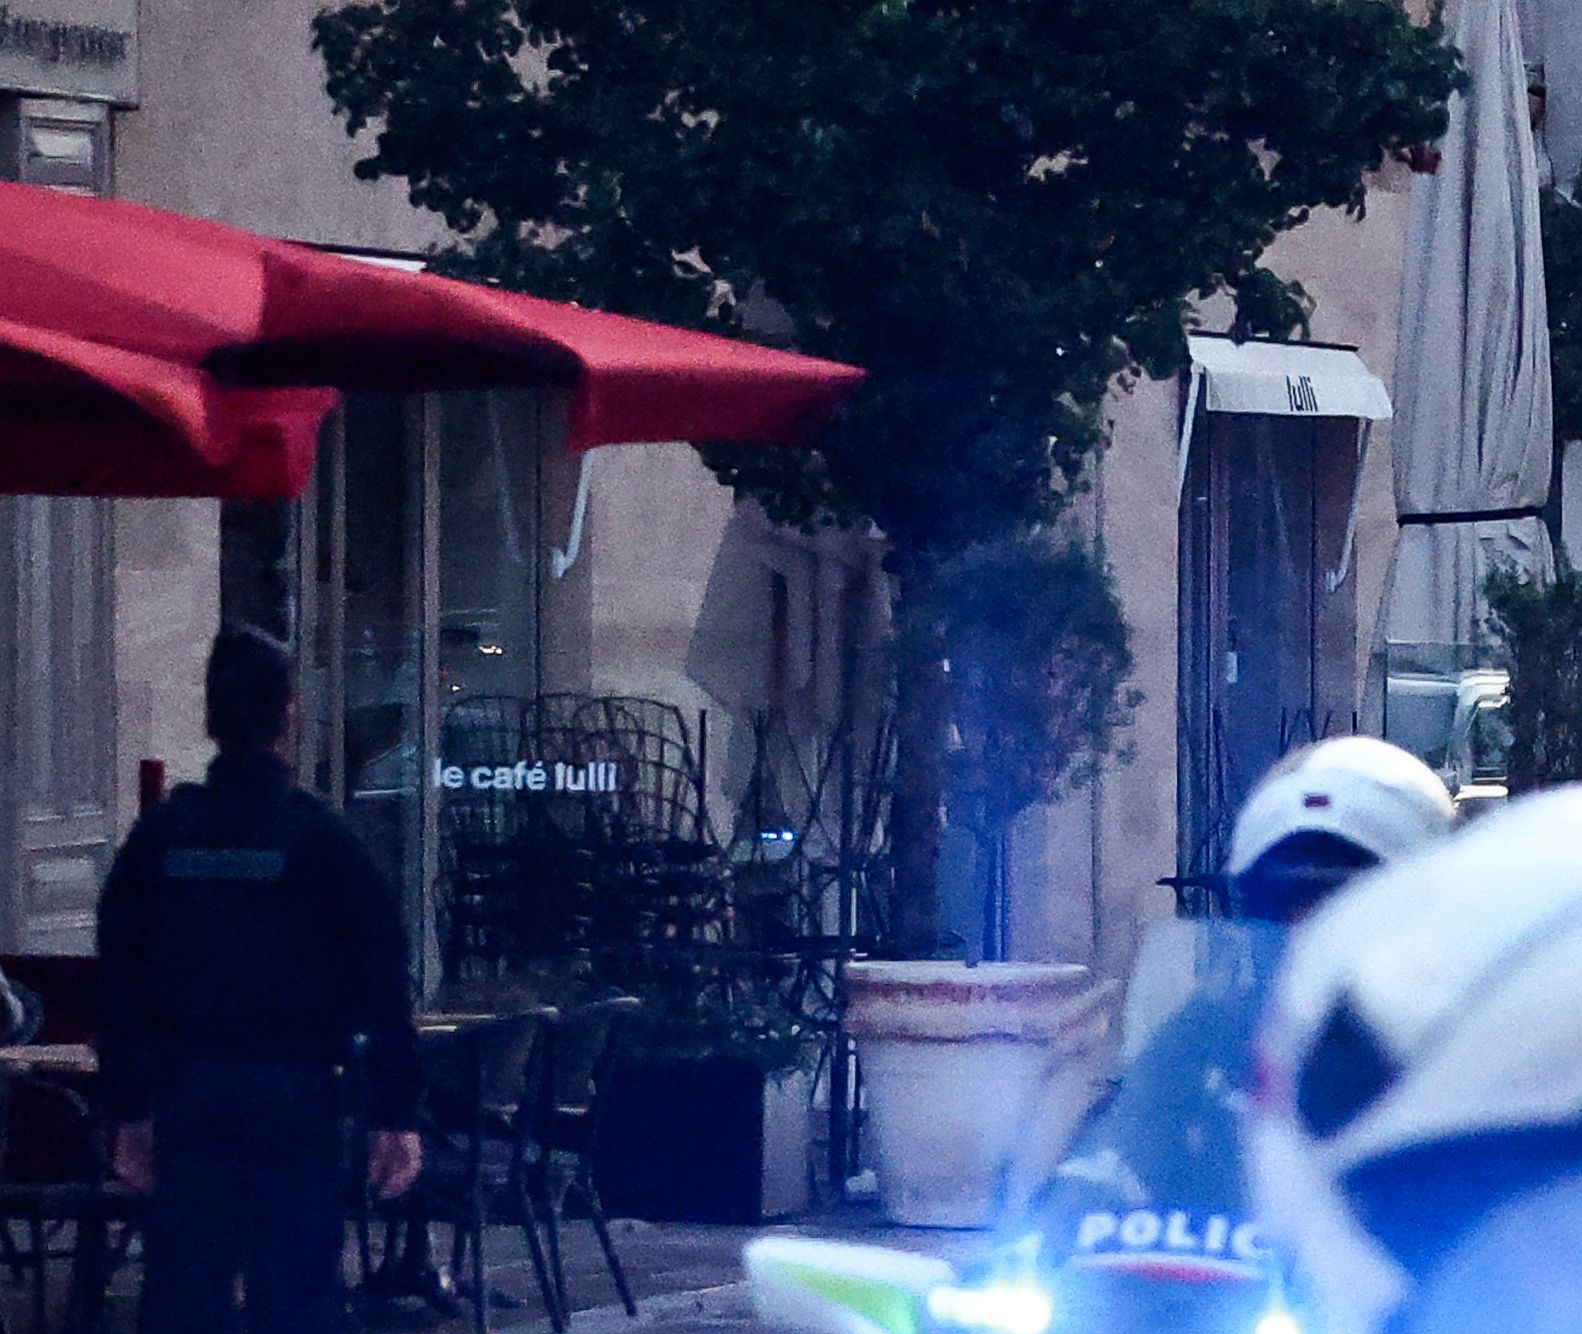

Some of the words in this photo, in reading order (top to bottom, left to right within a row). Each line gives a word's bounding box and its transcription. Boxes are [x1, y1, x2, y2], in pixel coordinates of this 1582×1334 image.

[1286, 376, 1318, 411] lulli
[434, 758, 464, 788] le
[471, 761, 547, 790] café
[555, 762, 617, 791] lulli
[1076, 1210, 1264, 1260] POLIC
